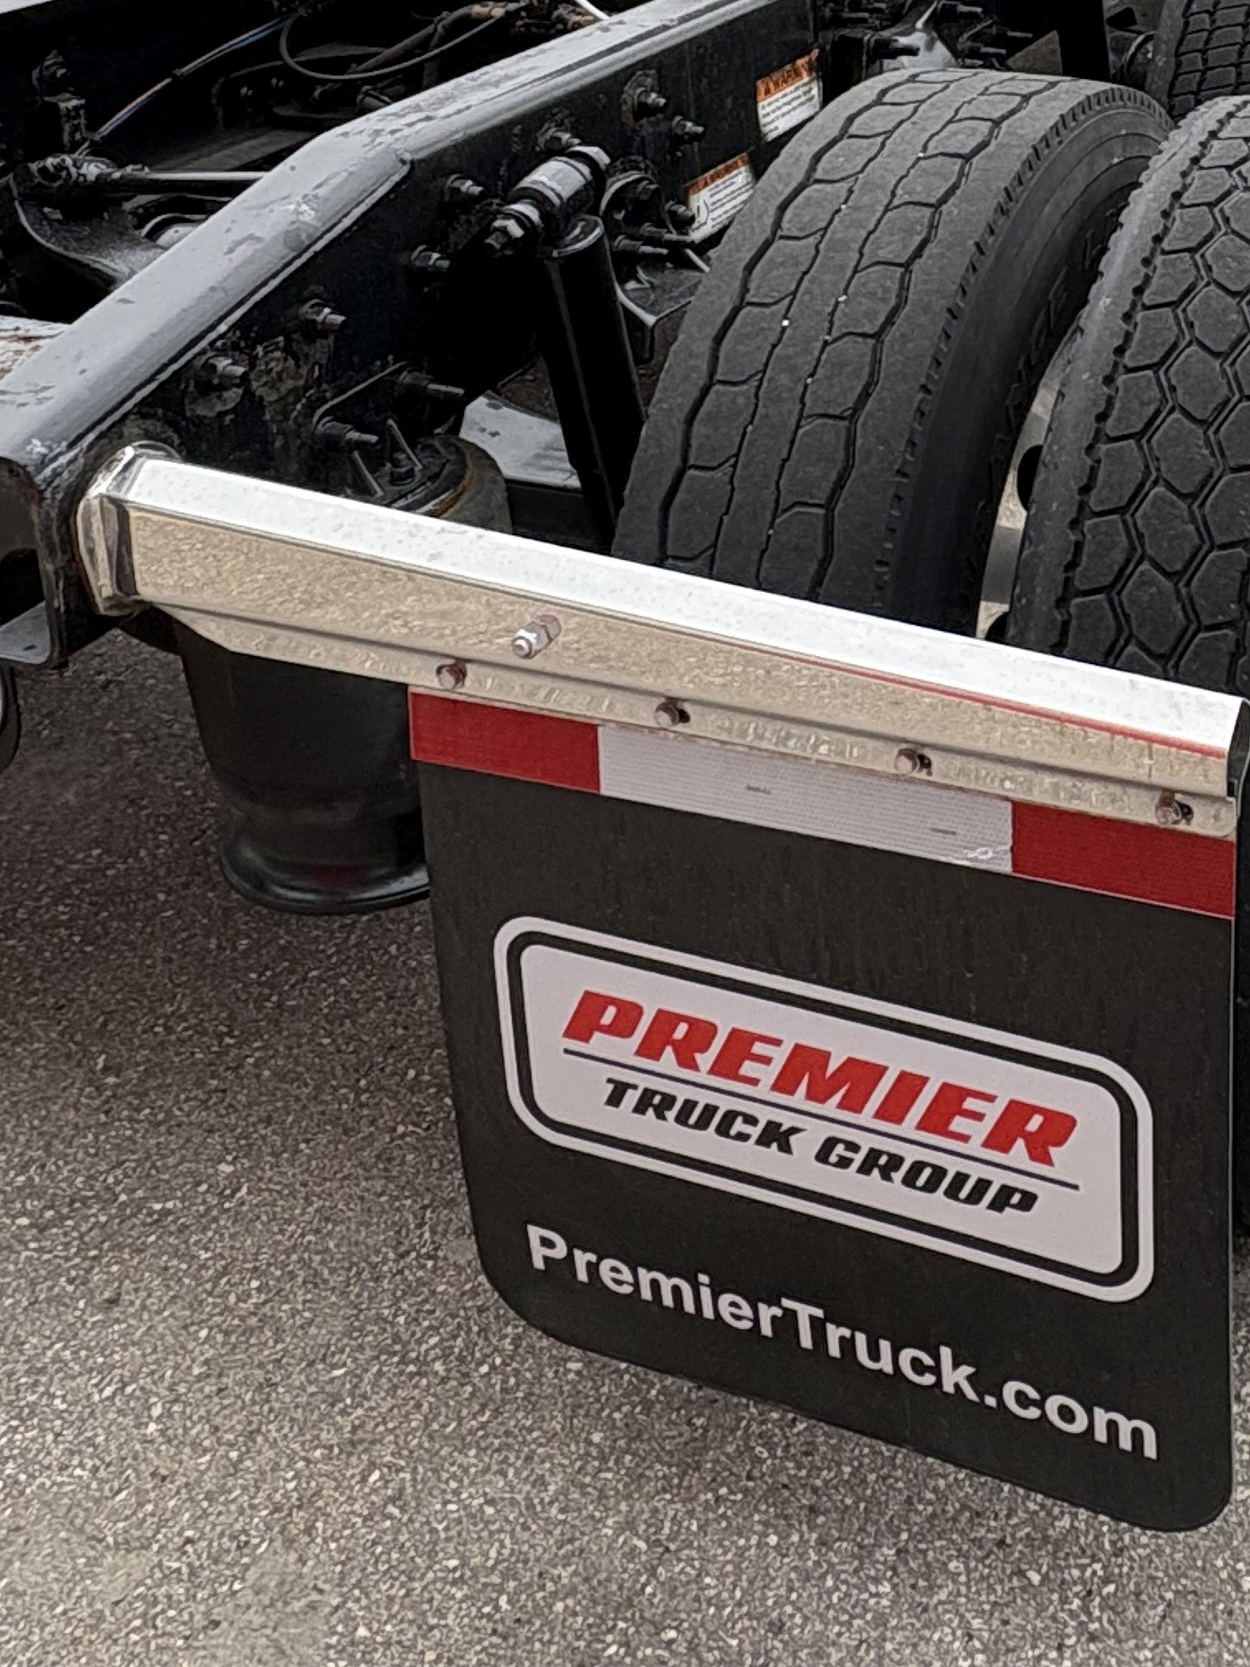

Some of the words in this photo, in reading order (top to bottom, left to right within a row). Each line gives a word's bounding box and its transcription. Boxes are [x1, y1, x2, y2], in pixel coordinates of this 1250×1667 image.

[562, 989, 1077, 1167] PREMIER
[604, 1077, 808, 1156] TRUCK
[814, 1134, 1039, 1215] GROUP
[526, 1224, 1158, 1460] PremierTruck.com
